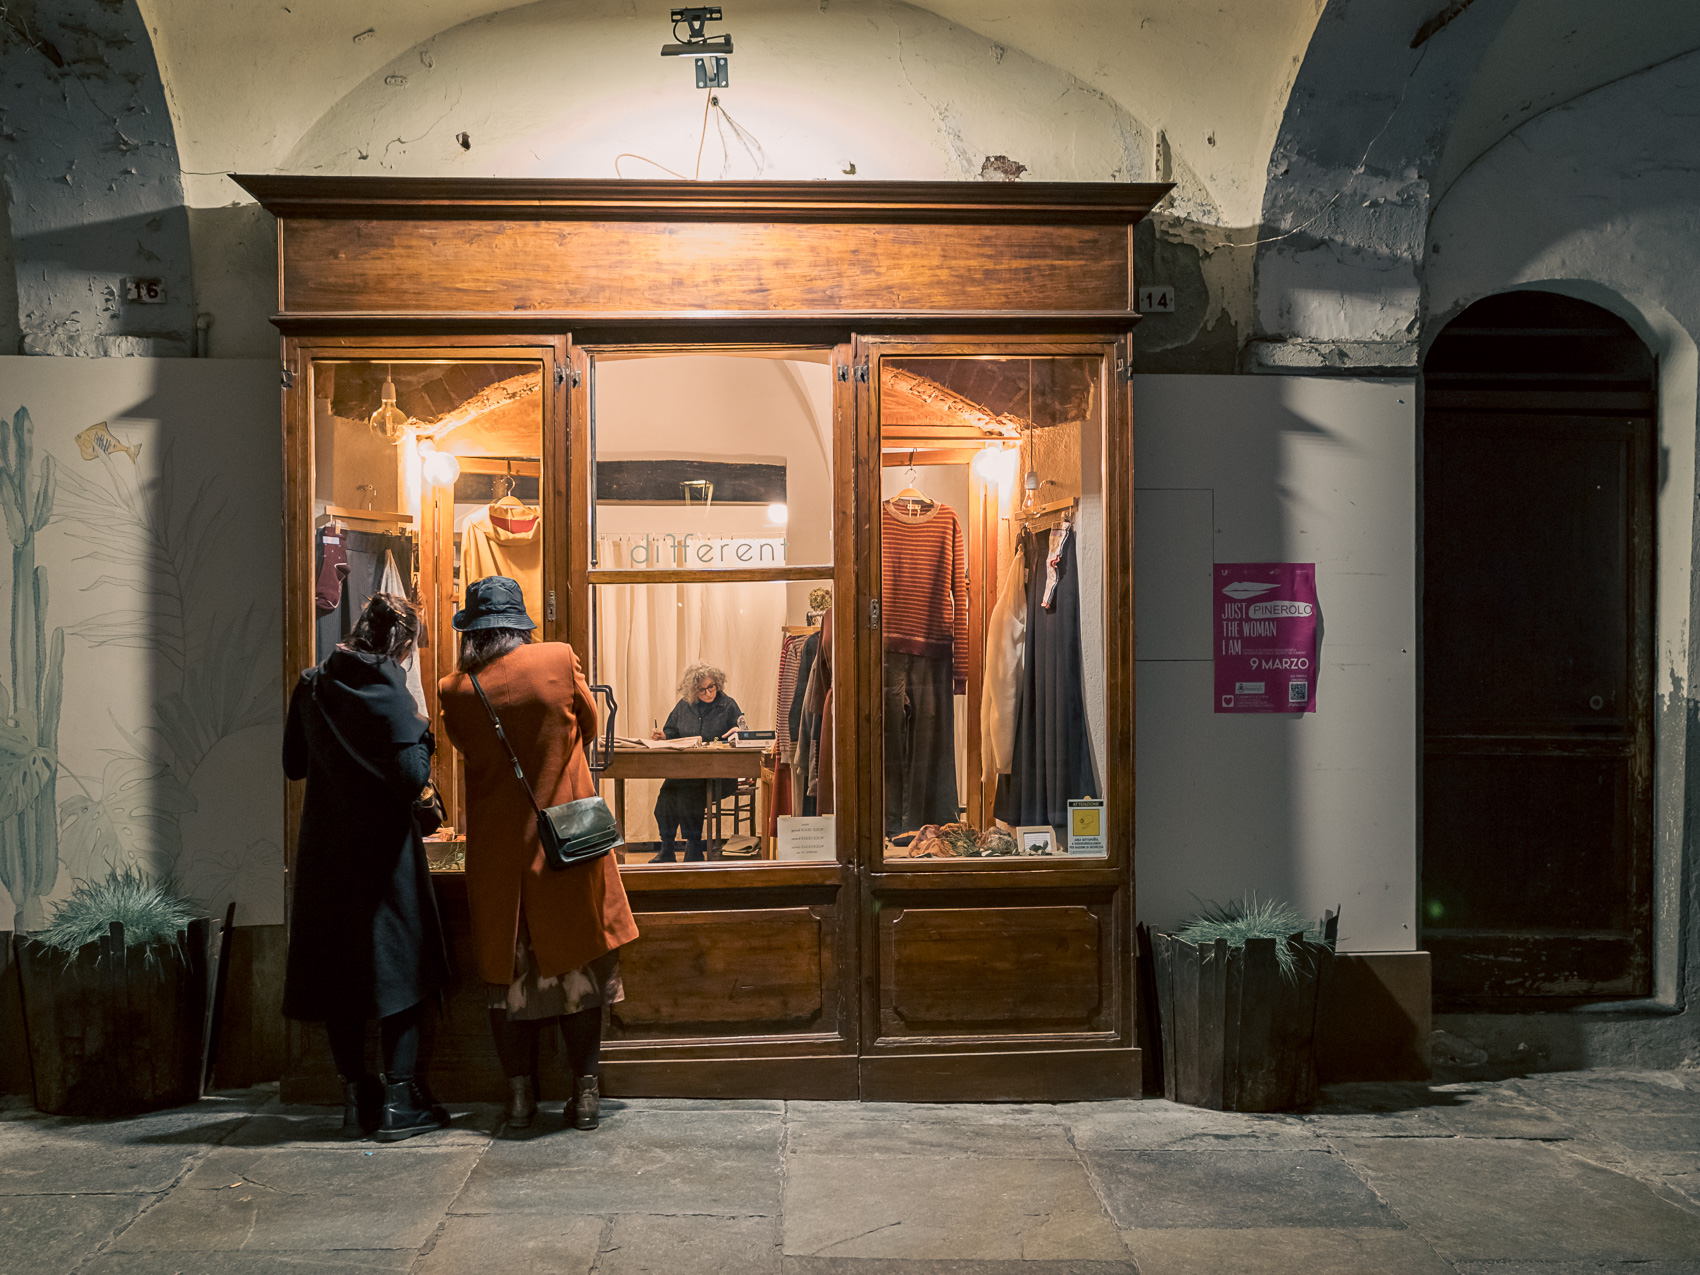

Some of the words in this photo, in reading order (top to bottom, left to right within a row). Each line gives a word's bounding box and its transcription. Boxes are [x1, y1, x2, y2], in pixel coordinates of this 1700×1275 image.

[135, 282, 159, 299] 16
[1146, 292, 1168, 308] 14
[630, 533, 790, 564] different
[1222, 602, 1247, 619] JUST
[1253, 605, 1313, 615] PINEROLO
[1222, 621, 1240, 637] THE
[1242, 621, 1277, 637] WOMAN
[1222, 639, 1226, 655] I
[1228, 639, 1242, 655] AM
[1250, 657, 1259, 670] 9
[1261, 657, 1309, 670] MARZO
